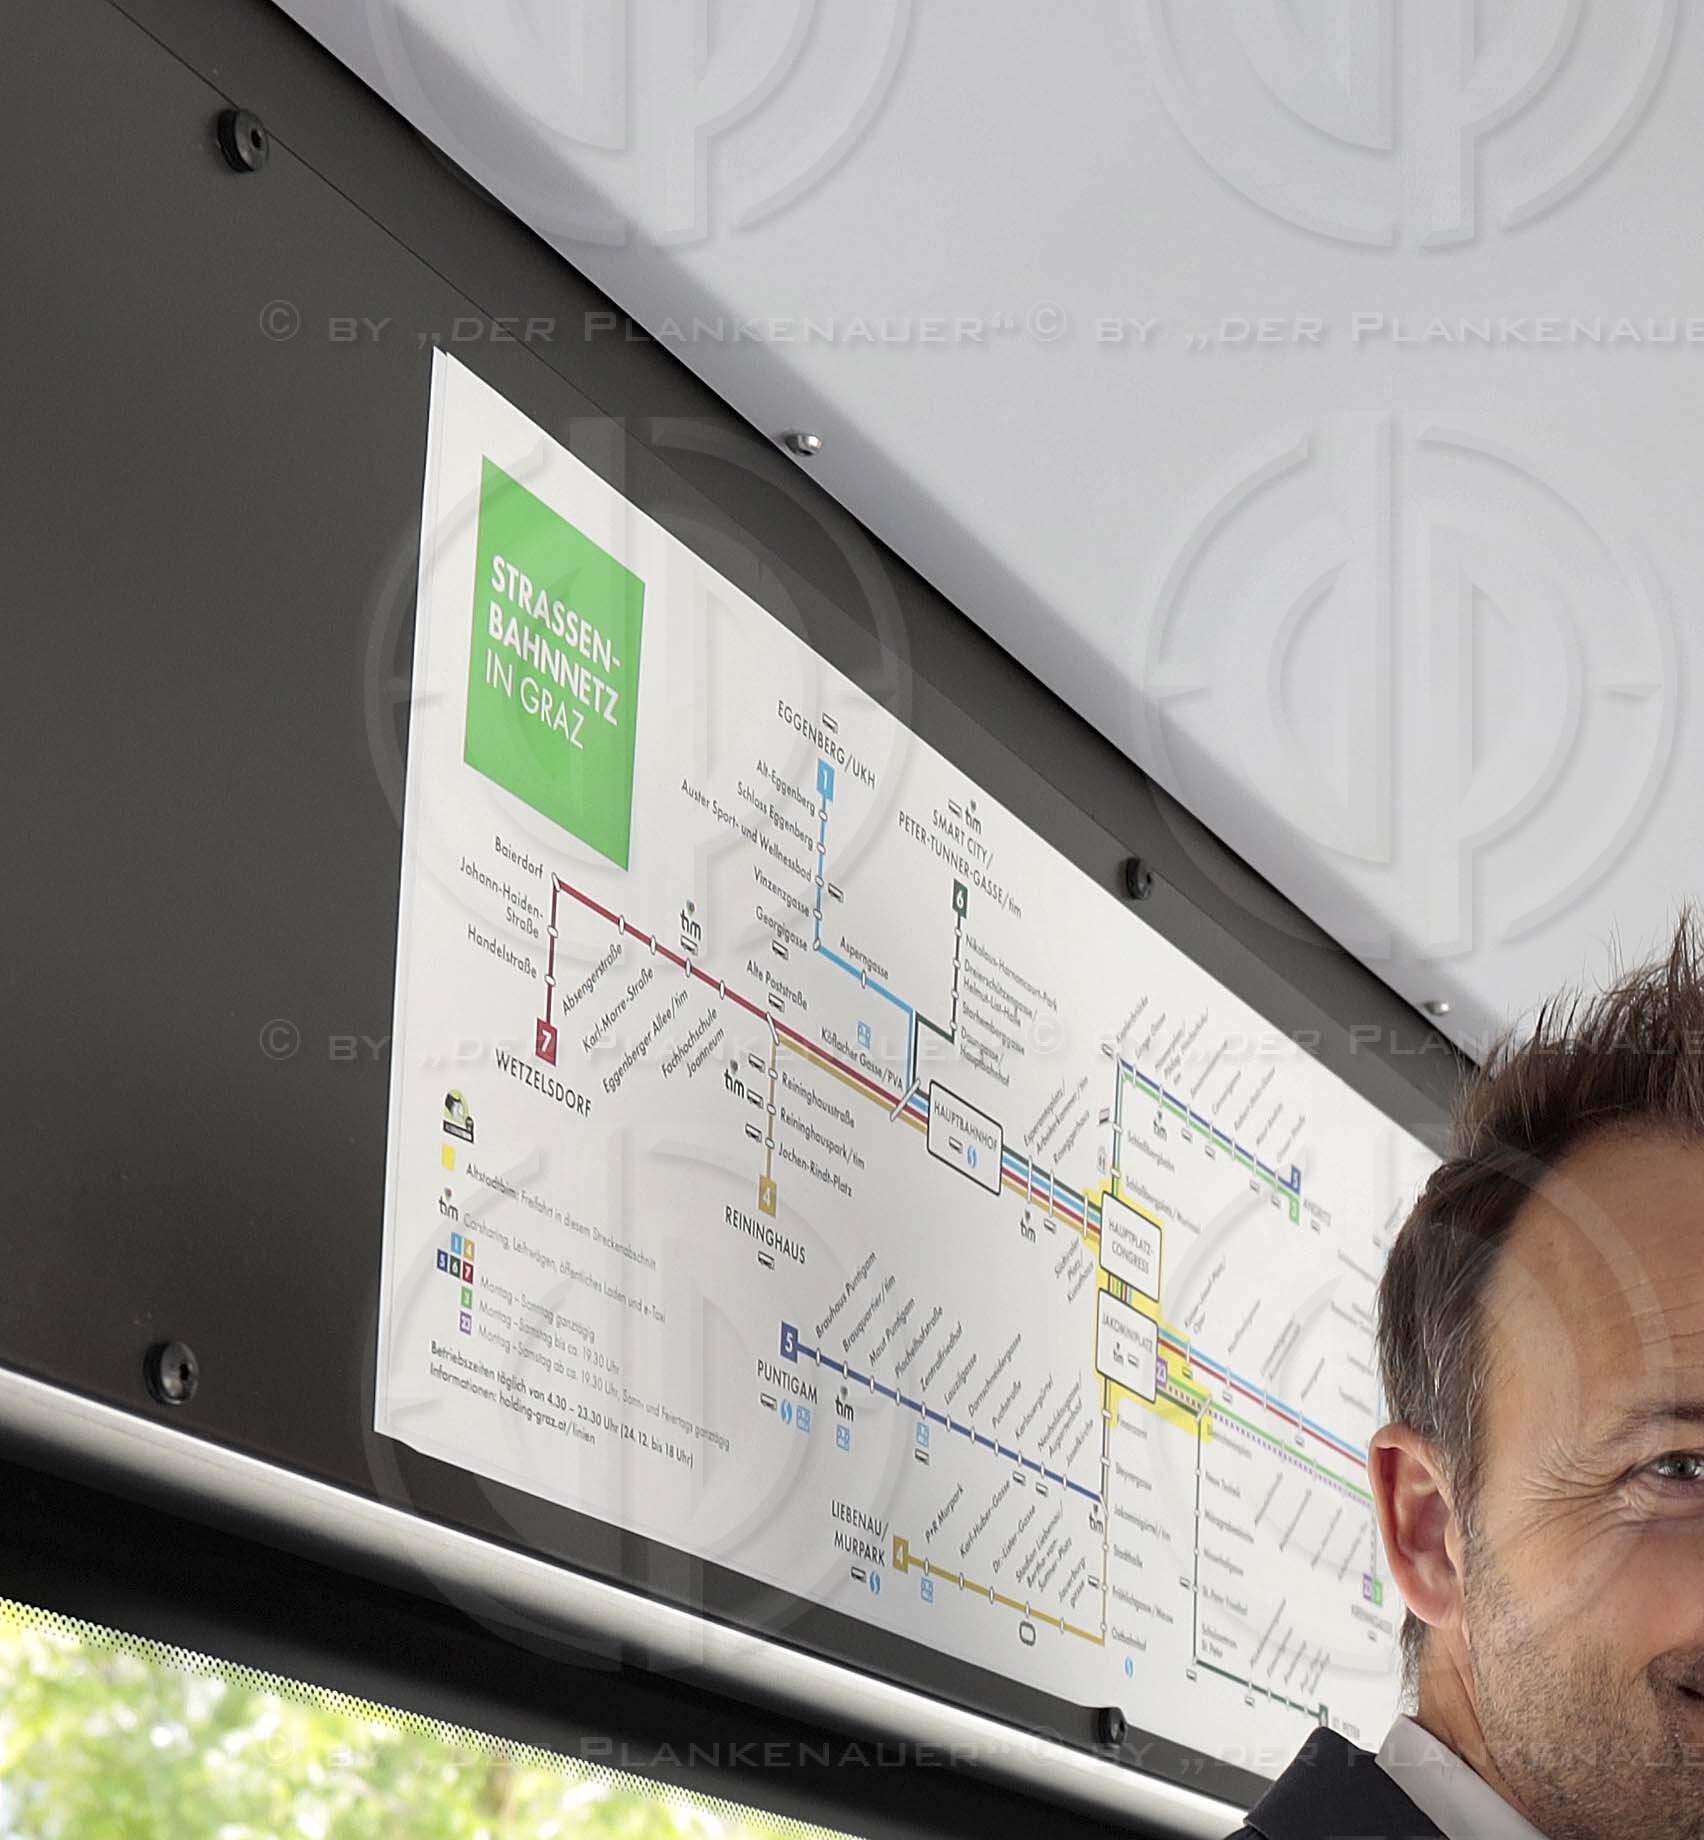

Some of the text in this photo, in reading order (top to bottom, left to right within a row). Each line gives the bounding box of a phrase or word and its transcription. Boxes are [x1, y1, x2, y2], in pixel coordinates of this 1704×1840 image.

[491, 555, 621, 671] STRASSEN-
[488, 601, 619, 727] BAHNNETZ
[486, 649, 584, 751] IN GRAZ
[769, 804, 814, 852] Eggenberg
[933, 809, 965, 849] SMART
[495, 836, 544, 880] Baierdorf
[460, 856, 544, 920] Johann-Haiden-
[754, 866, 810, 918] Vinzenzgasse
[956, 890, 964, 910] 6
[506, 906, 540, 938] Straße
[562, 943, 623, 1017] Absengerstraße
[747, 960, 764, 981] Alte
[541, 1030, 552, 1053] 7
[602, 1032, 652, 1095] Eggenberger
[661, 1007, 718, 1080] Fachhochschule
[686, 1028, 725, 1078] Joanneum
[495, 1048, 592, 1118] WETZELSDORF
[724, 1069, 745, 1099] tim
[725, 1205, 806, 1266] REININGHAUS
[784, 1332, 793, 1352] 5
[757, 1360, 818, 1405] PUNTIGAM
[835, 1395, 855, 1423] tim
[834, 1530, 886, 1568] MURPARK
